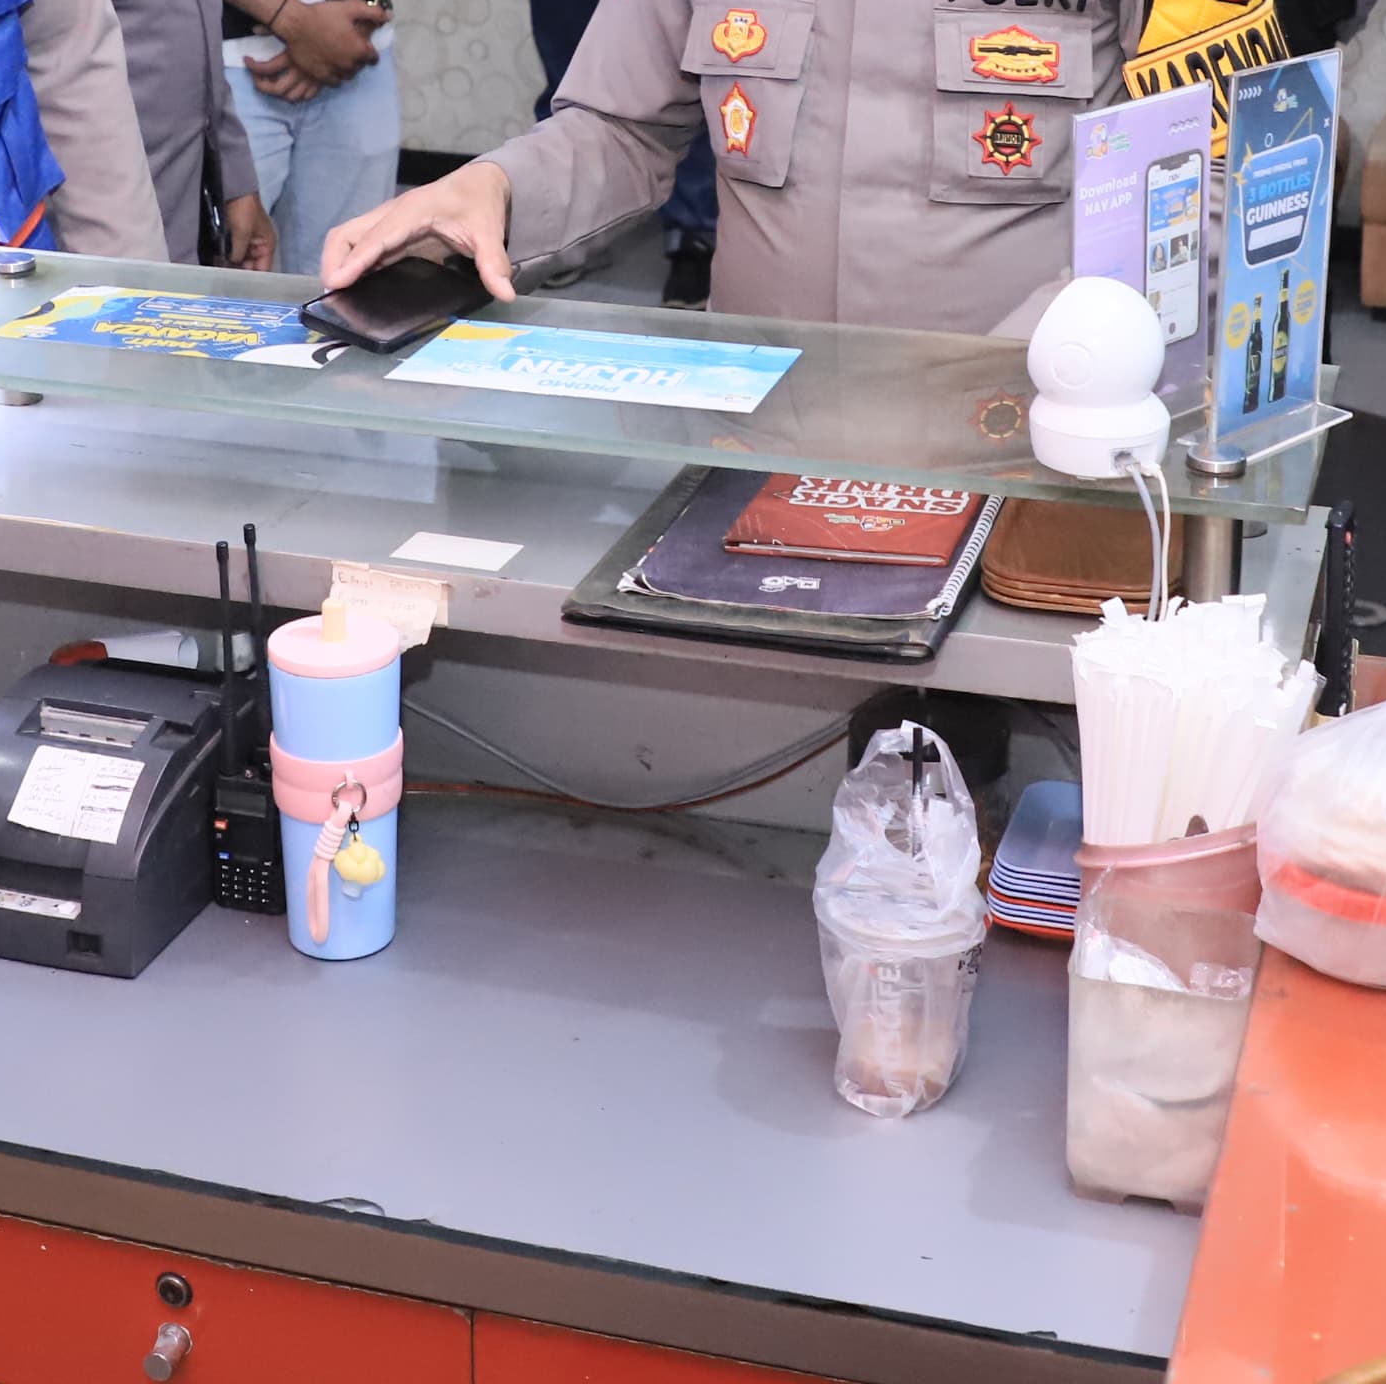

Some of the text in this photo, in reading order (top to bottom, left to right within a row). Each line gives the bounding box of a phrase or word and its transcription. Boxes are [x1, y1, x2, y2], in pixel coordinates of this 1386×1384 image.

[1079, 172, 1138, 200] Download
[1258, 170, 1312, 201] BOTTLES
[1110, 191, 1134, 210] APP
[1245, 191, 1310, 226] GUINNESS
[93, 321, 262, 345] VAGANZA
[508, 357, 687, 387] HUJAN
[538, 379, 621, 393] PROMO
[790, 491, 965, 514] SNACK
